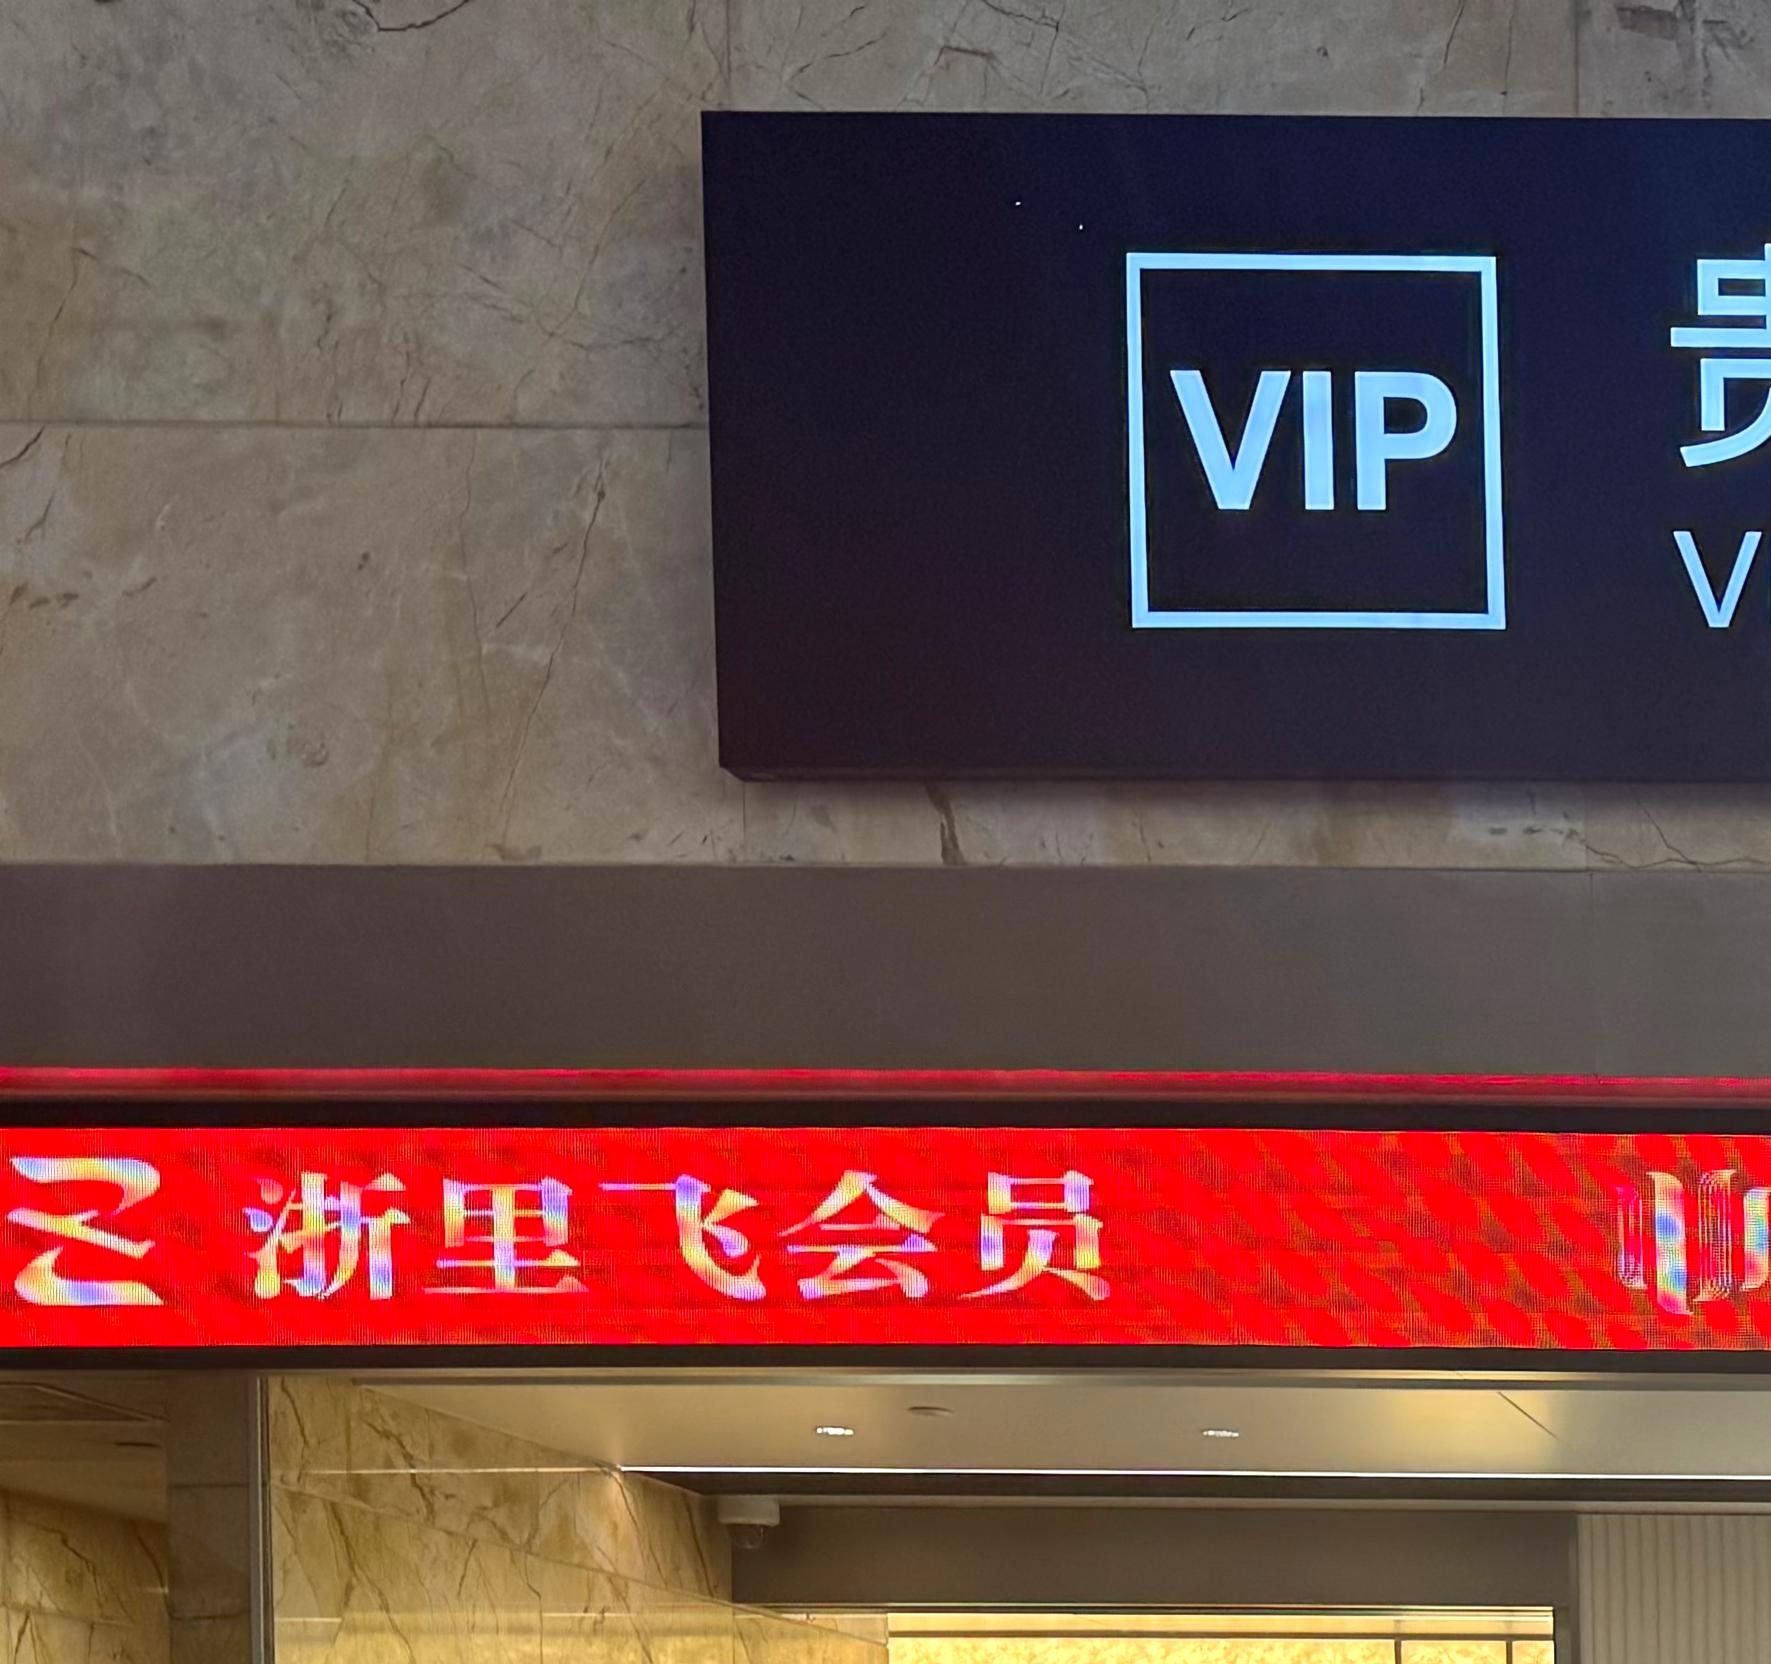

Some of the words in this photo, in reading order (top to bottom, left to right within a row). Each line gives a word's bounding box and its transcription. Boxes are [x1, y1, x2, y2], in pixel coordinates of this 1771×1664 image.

[1169, 369, 1457, 511] VIP
[244, 1169, 1112, 1301] 浙里飞会员
